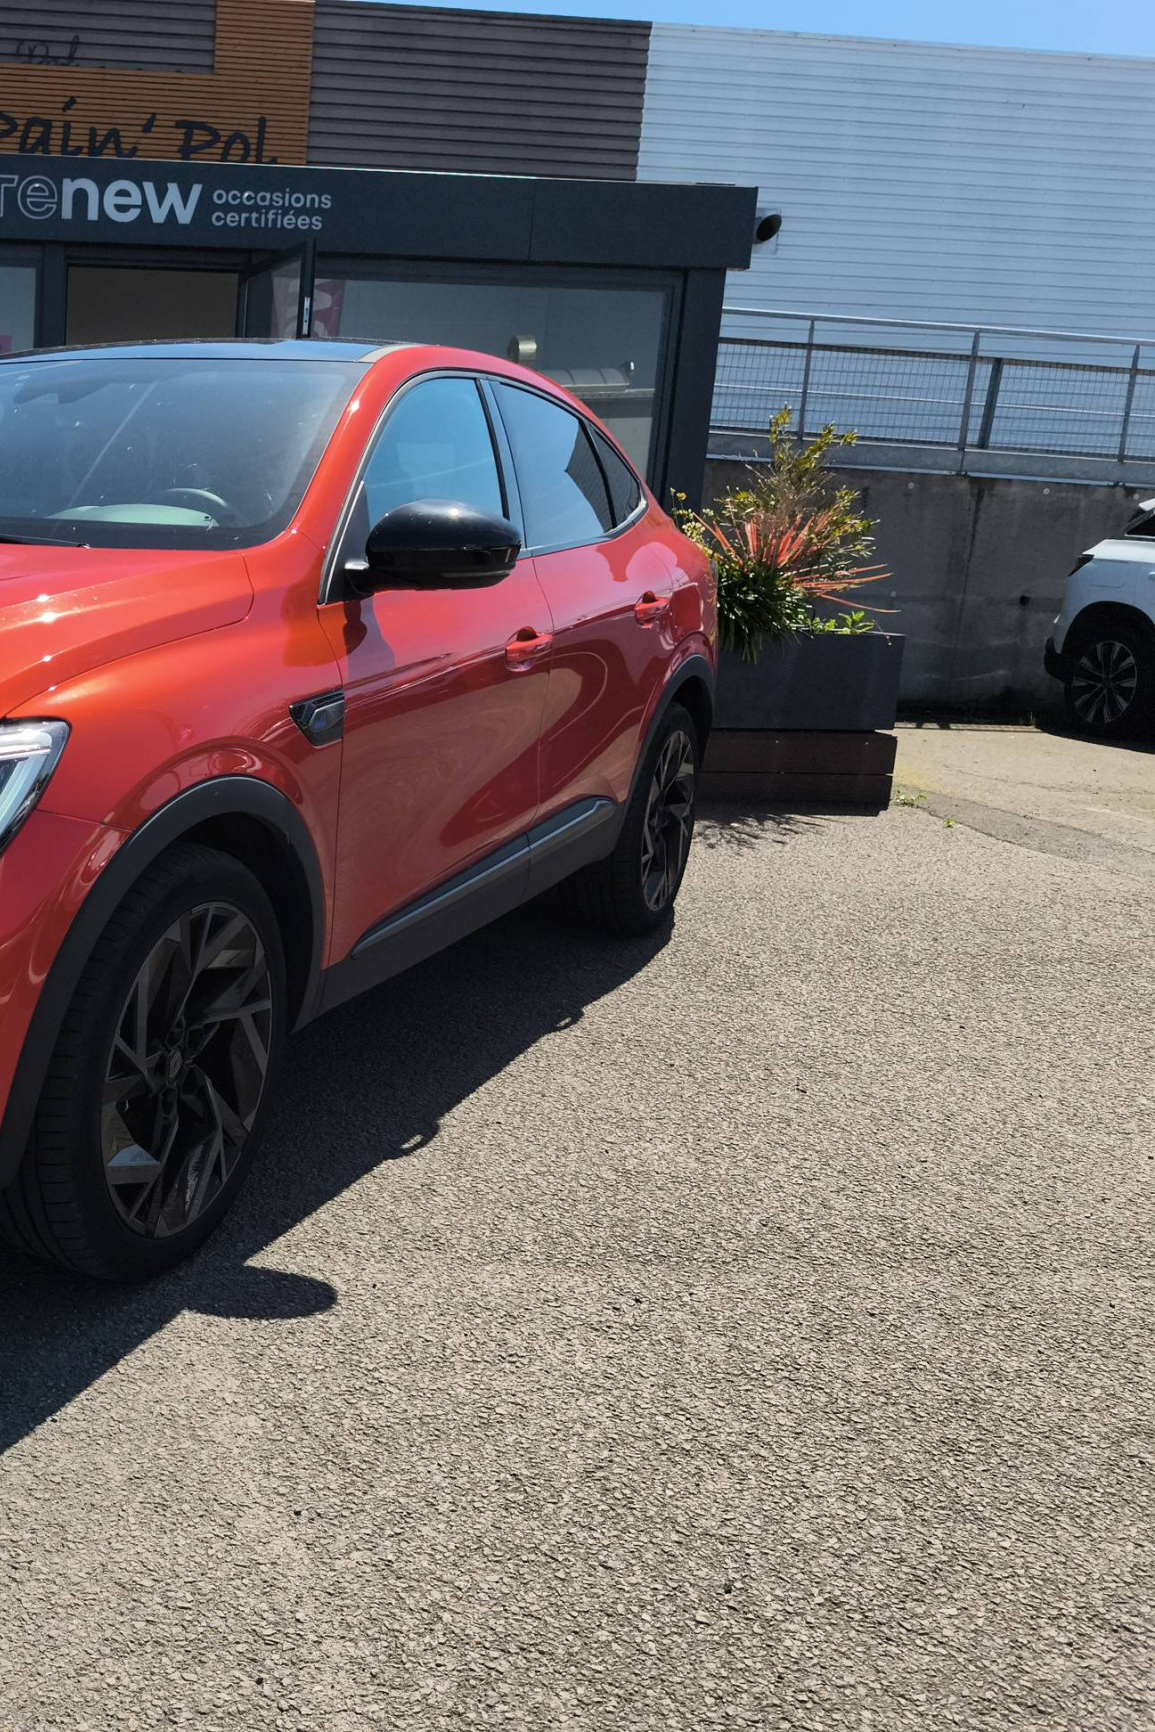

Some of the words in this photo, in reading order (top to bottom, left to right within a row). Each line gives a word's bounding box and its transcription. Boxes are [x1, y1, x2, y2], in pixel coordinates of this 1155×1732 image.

[175, 116, 278, 164] Pol
[212, 188, 332, 209] occasions
[211, 209, 323, 230] certifiées
